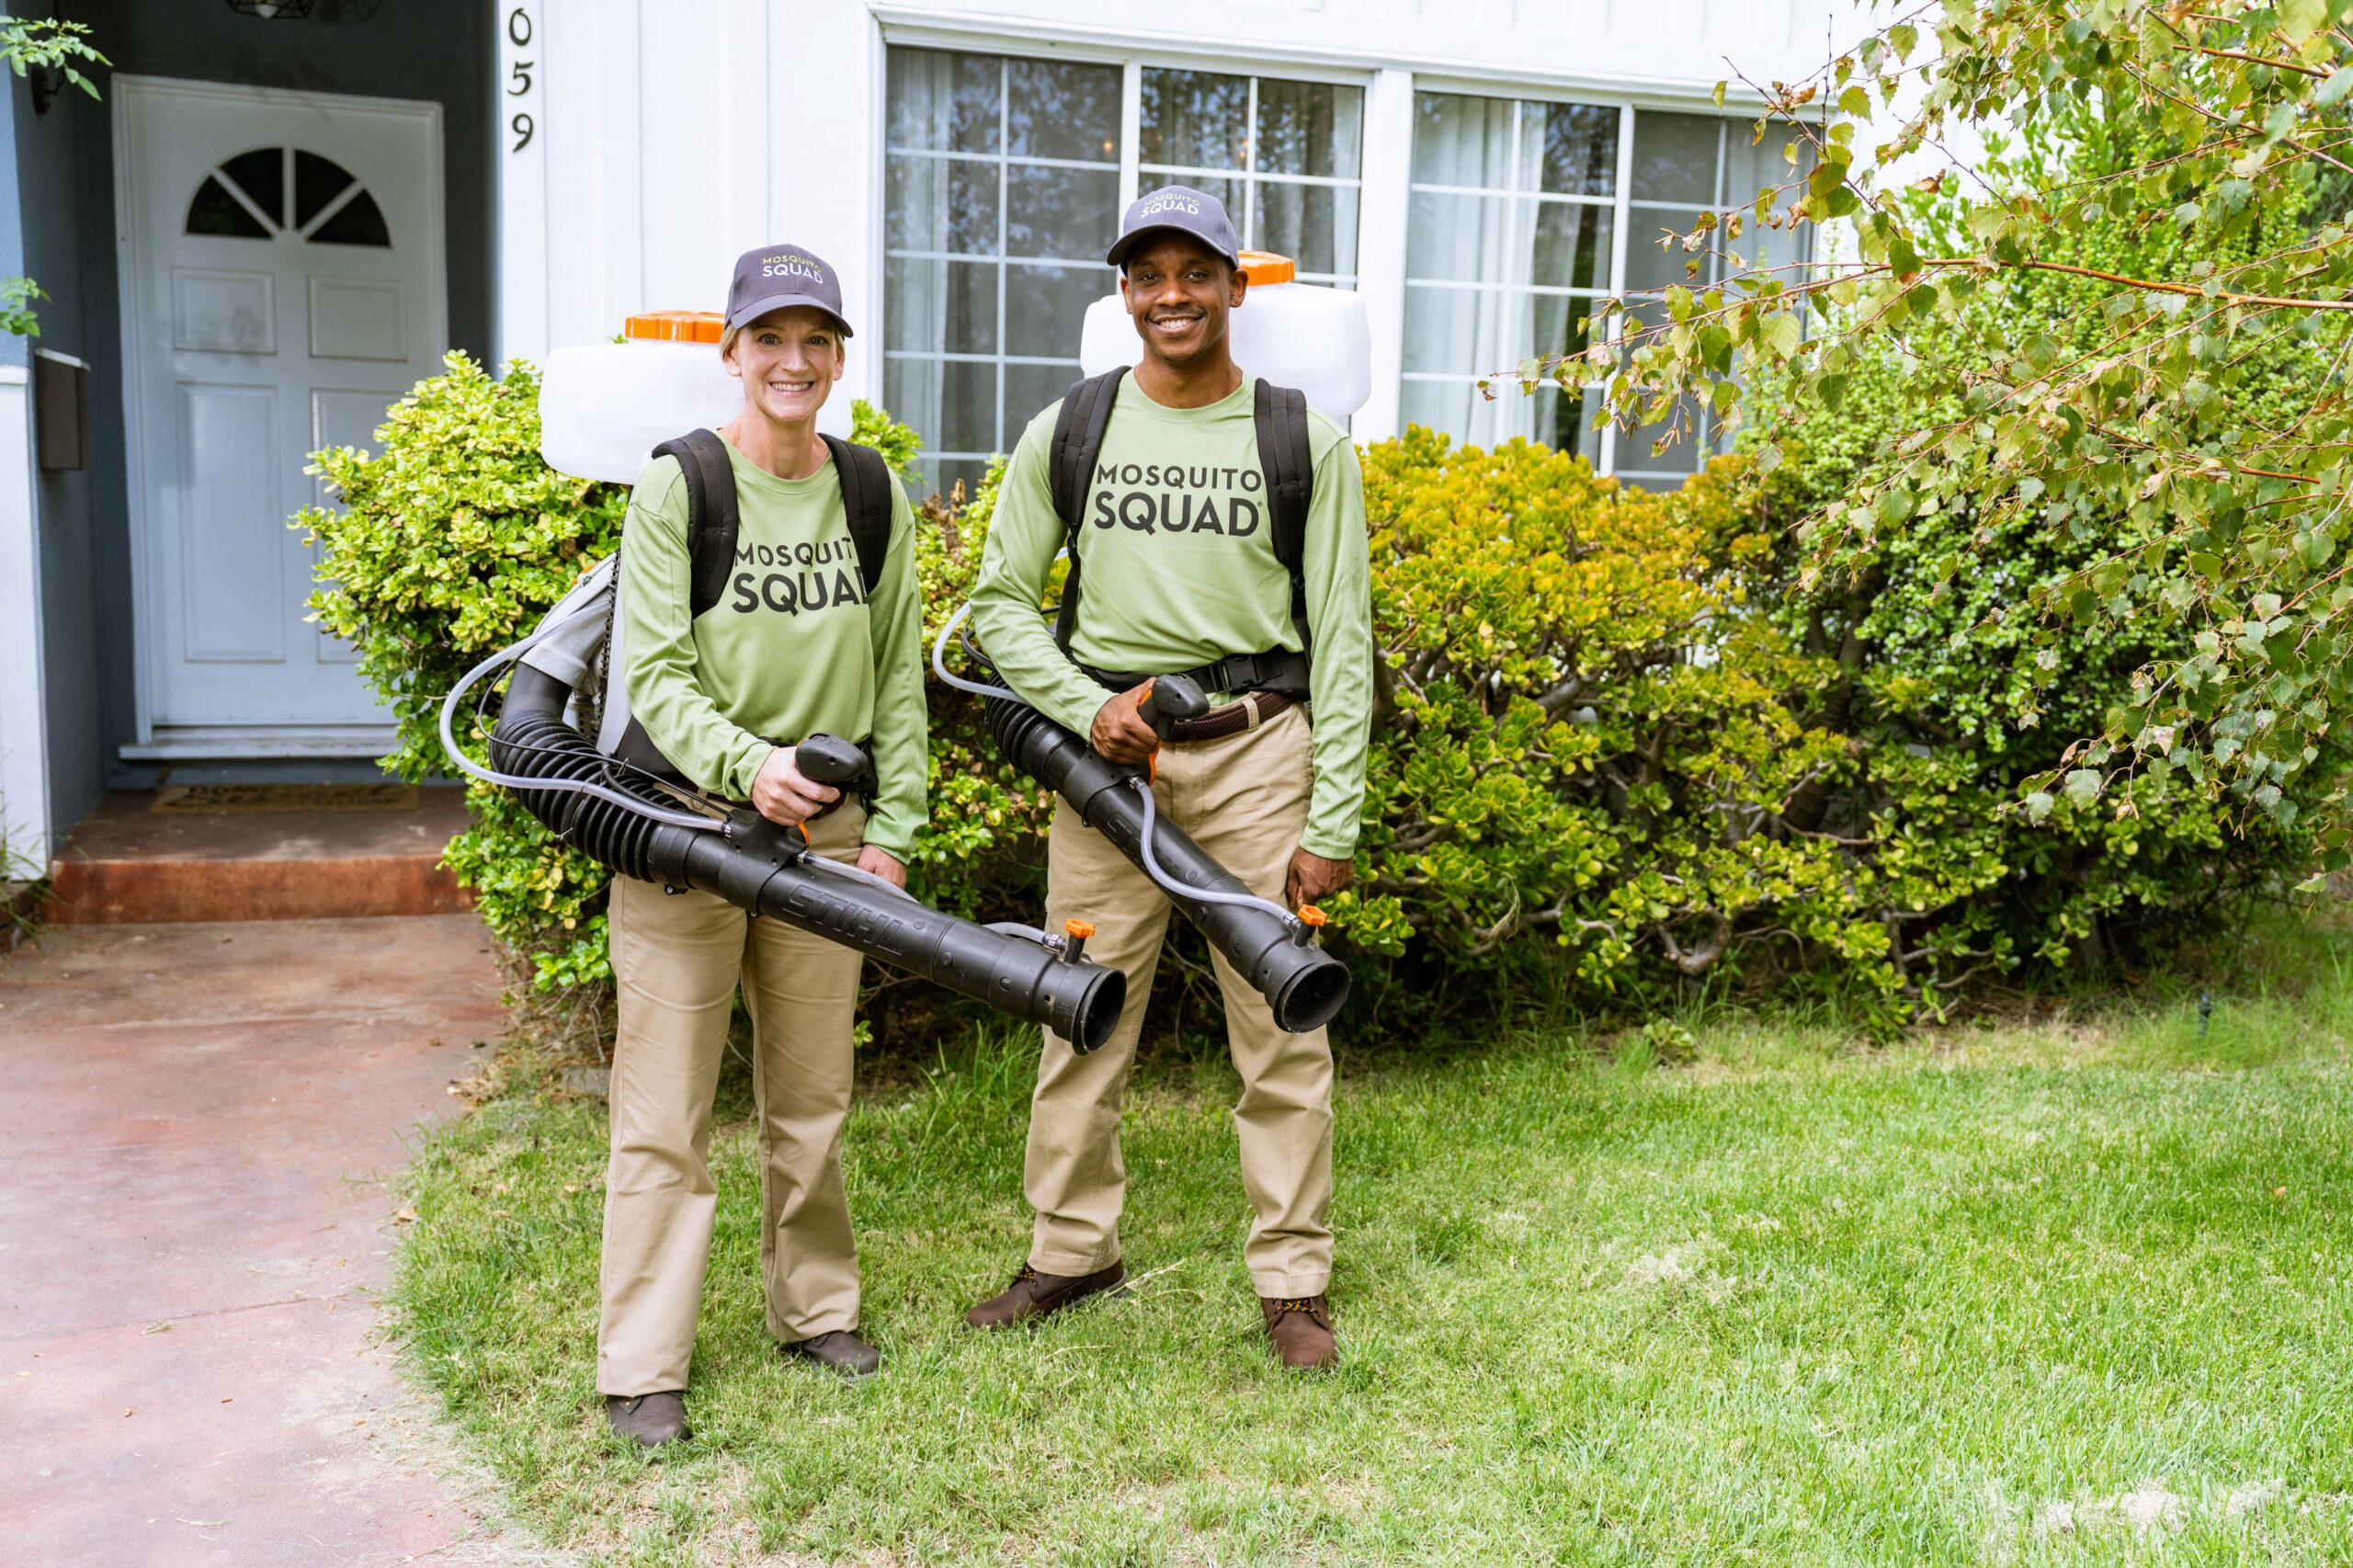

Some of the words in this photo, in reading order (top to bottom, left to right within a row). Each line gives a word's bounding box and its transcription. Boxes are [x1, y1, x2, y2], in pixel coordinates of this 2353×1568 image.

[506, 7, 534, 153] 059
[1141, 200, 1199, 218] SQUAD
[1144, 193, 1199, 207] MOSQUITO
[762, 255, 822, 273] MOSQUITO
[762, 263, 824, 284] SQUAD
[1097, 462, 1262, 493] MOSQUITO
[734, 537, 853, 567] MOSQUIT
[781, 884, 904, 957] STIHL
